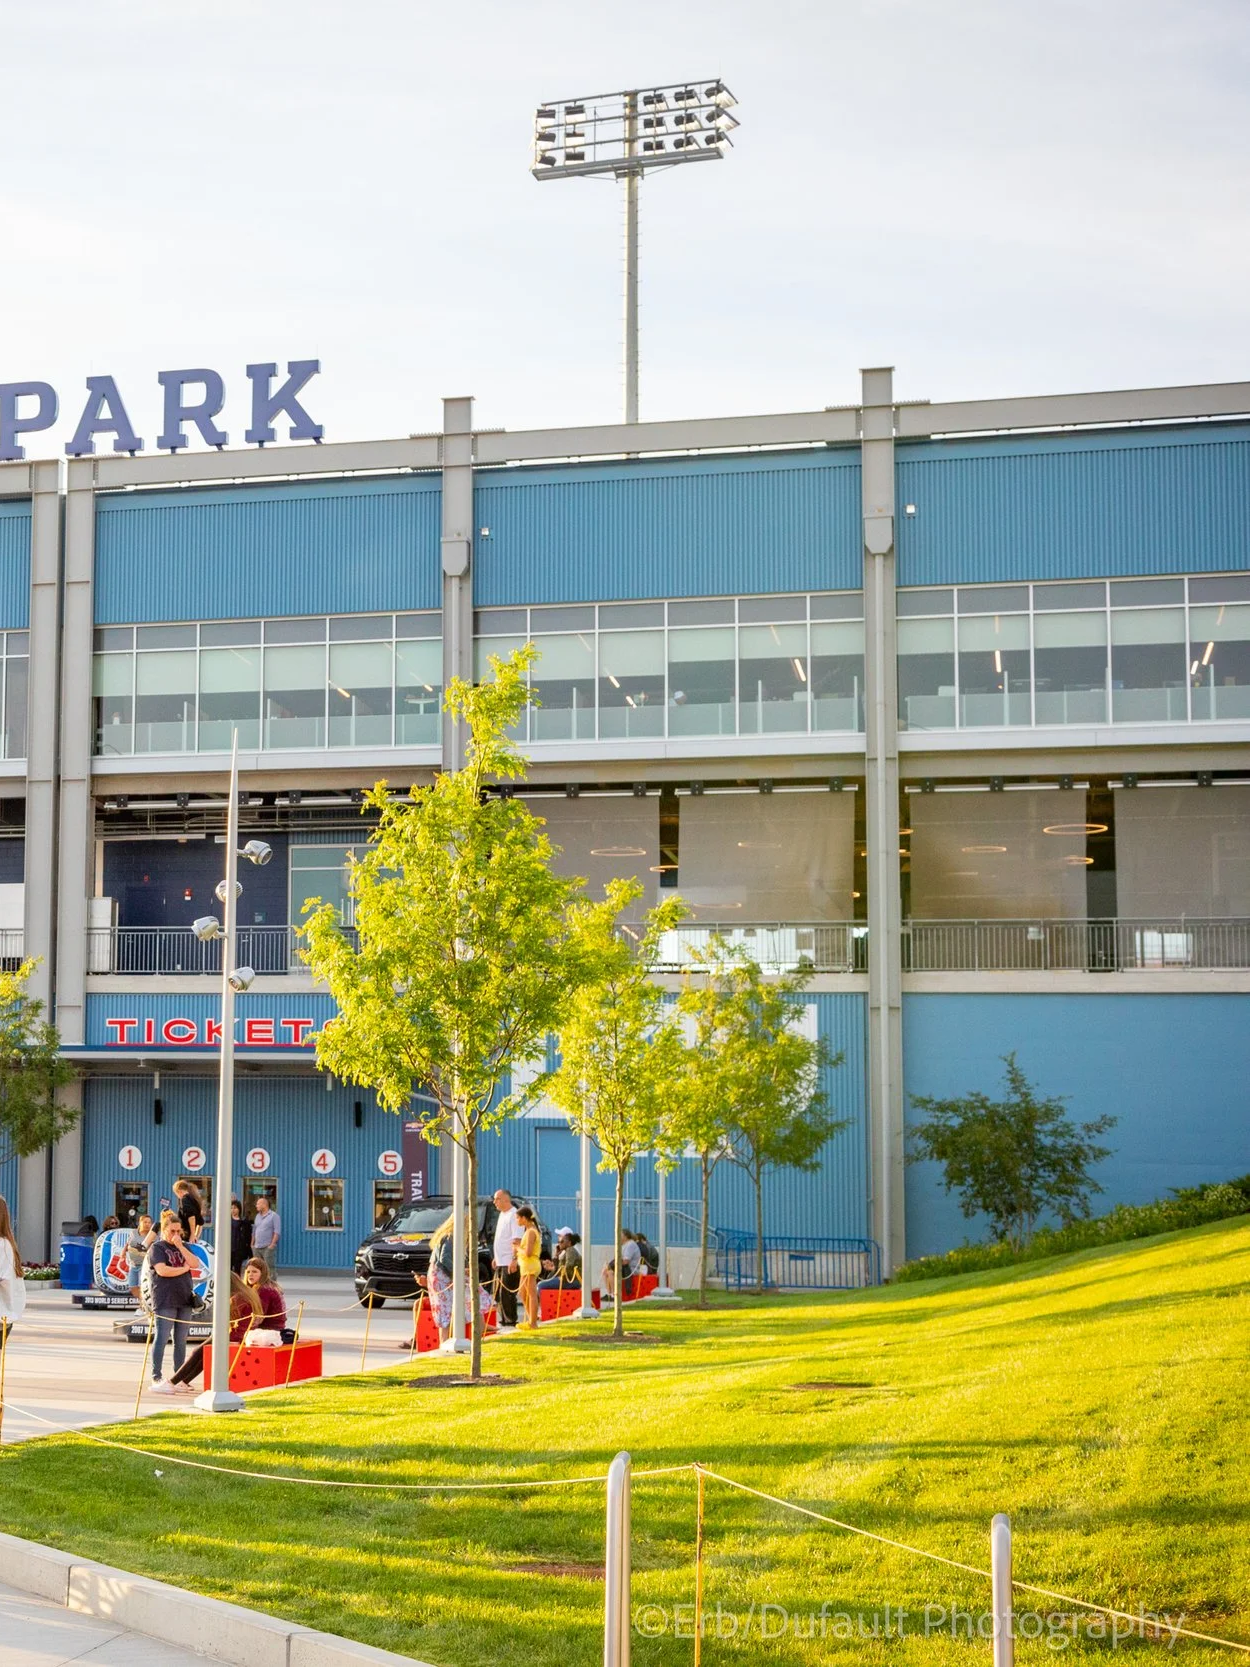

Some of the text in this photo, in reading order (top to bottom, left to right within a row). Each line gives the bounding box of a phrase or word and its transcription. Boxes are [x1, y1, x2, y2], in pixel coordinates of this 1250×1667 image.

[106, 1018, 337, 1045] TICKET
[126, 1149, 134, 1167] 1
[187, 1150, 200, 1168] 2
[251, 1151, 265, 1170] 3
[315, 1152, 329, 1171] 4
[383, 1154, 397, 1173] 5
[189, 1326, 213, 1336] CHAMP
